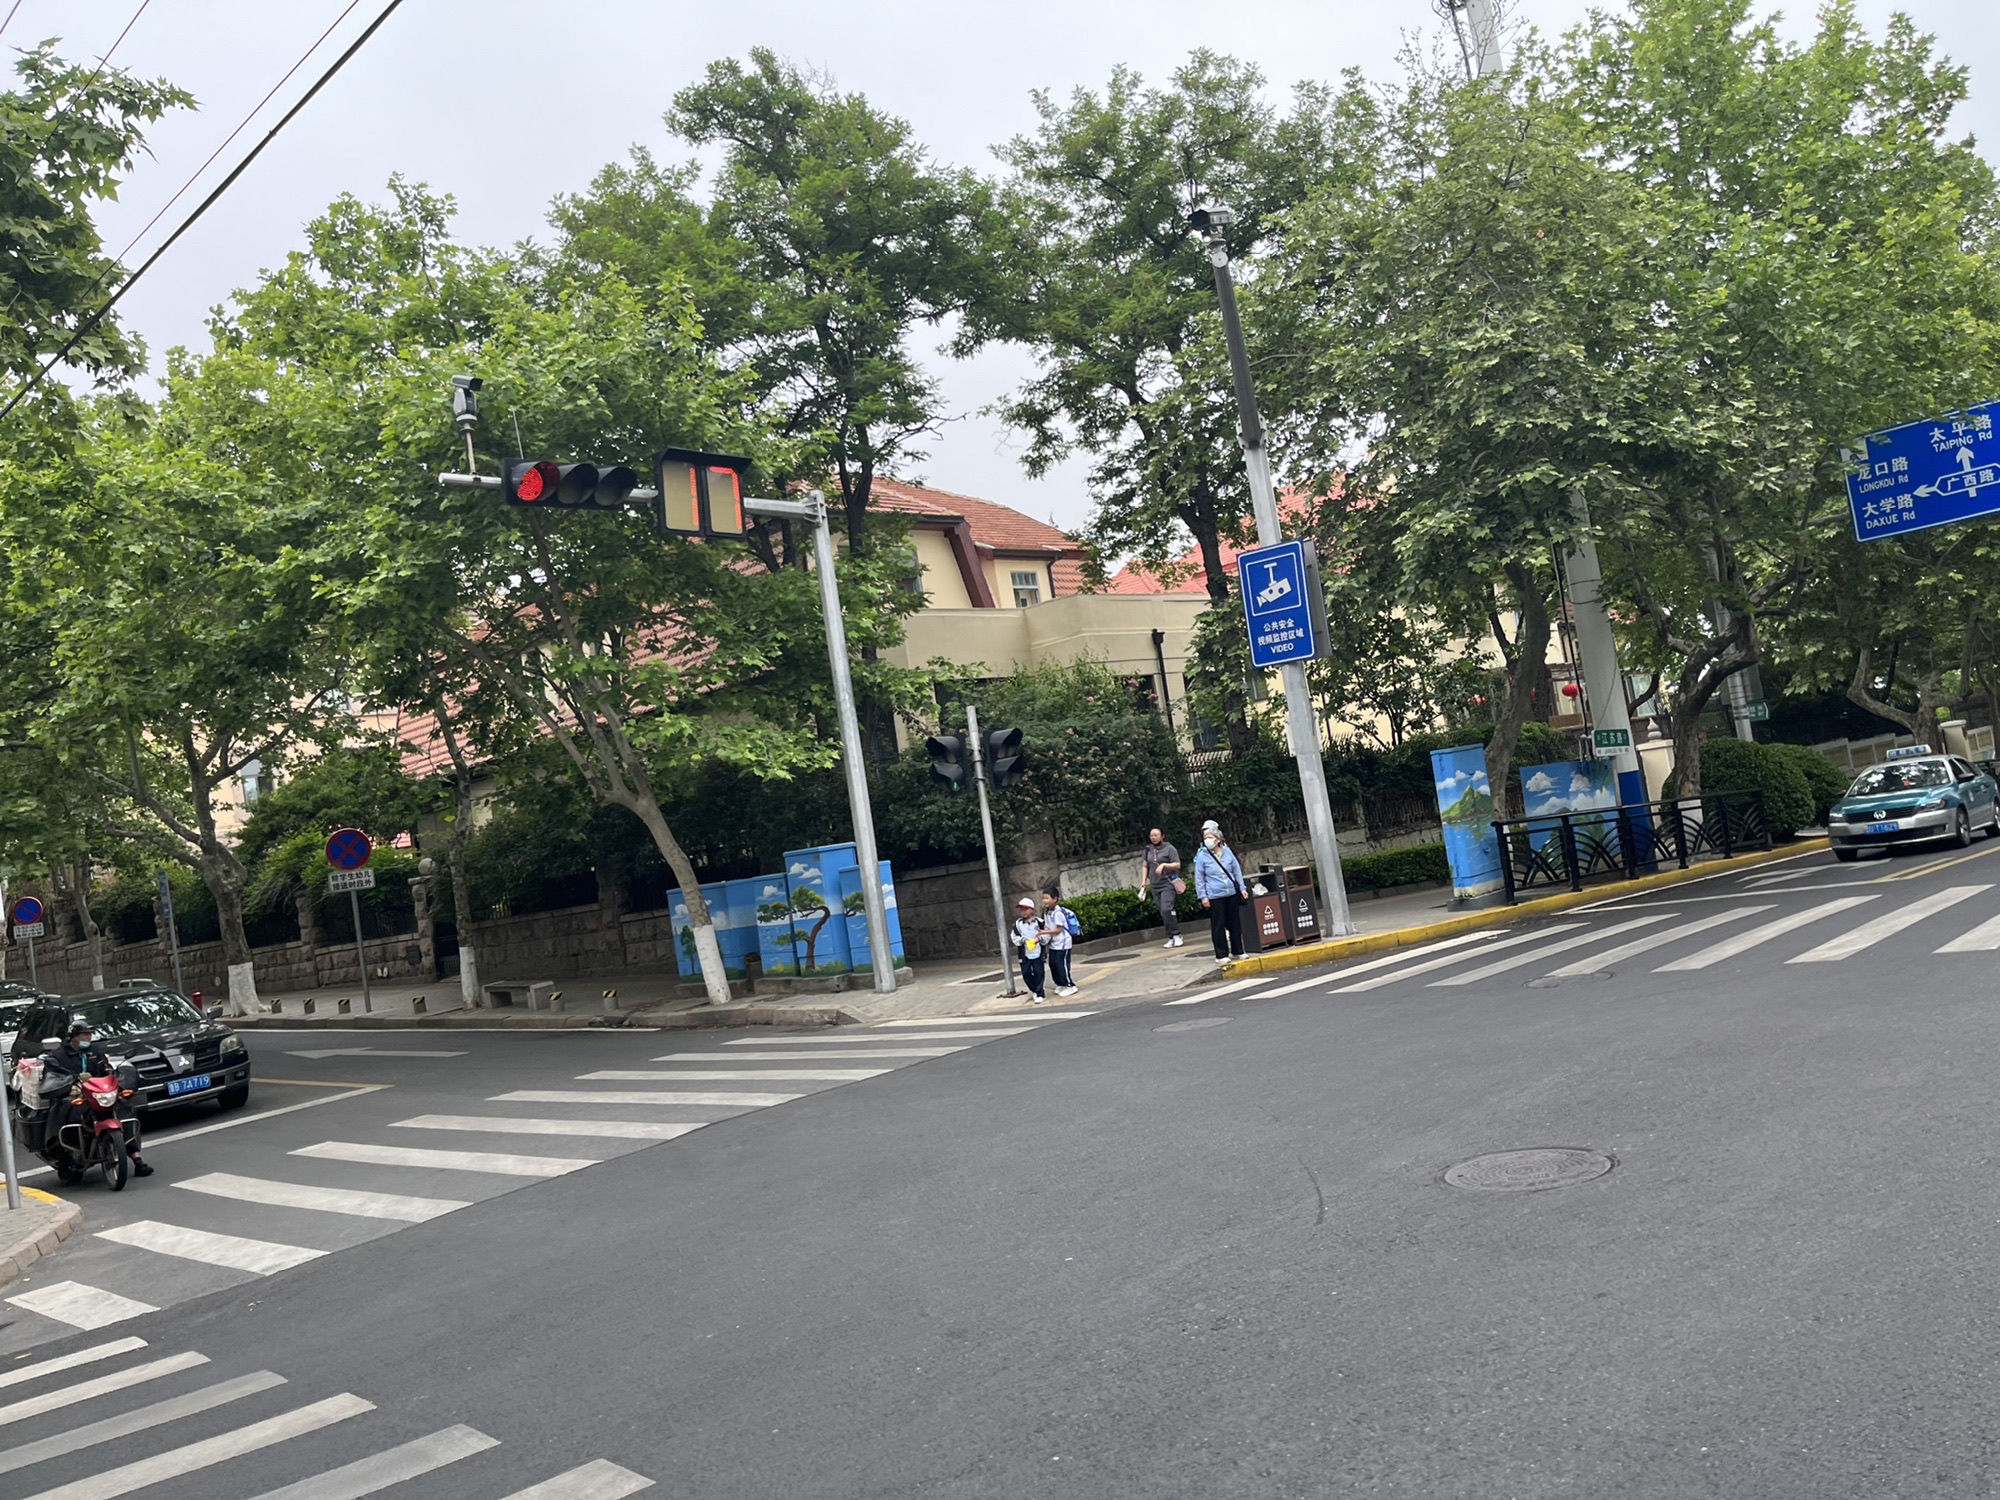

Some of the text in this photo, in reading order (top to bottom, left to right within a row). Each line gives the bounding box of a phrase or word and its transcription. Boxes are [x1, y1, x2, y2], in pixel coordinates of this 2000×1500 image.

[1929, 414, 1992, 443] 太平路
[1933, 430, 1993, 452] TAIPING Rd
[1857, 456, 1908, 481] 龙口路
[1859, 474, 1909, 493] LONGKOU Rd
[1947, 469, 1995, 491] 广西路
[689, 465, 743, 530] 17
[1862, 493, 1914, 518] 大学路
[1866, 511, 1915, 529] DAXUE Rd
[1263, 618, 1295, 632] 公共安全
[1257, 628, 1304, 645] 视频监控区域
[1271, 642, 1294, 654] VIDEO
